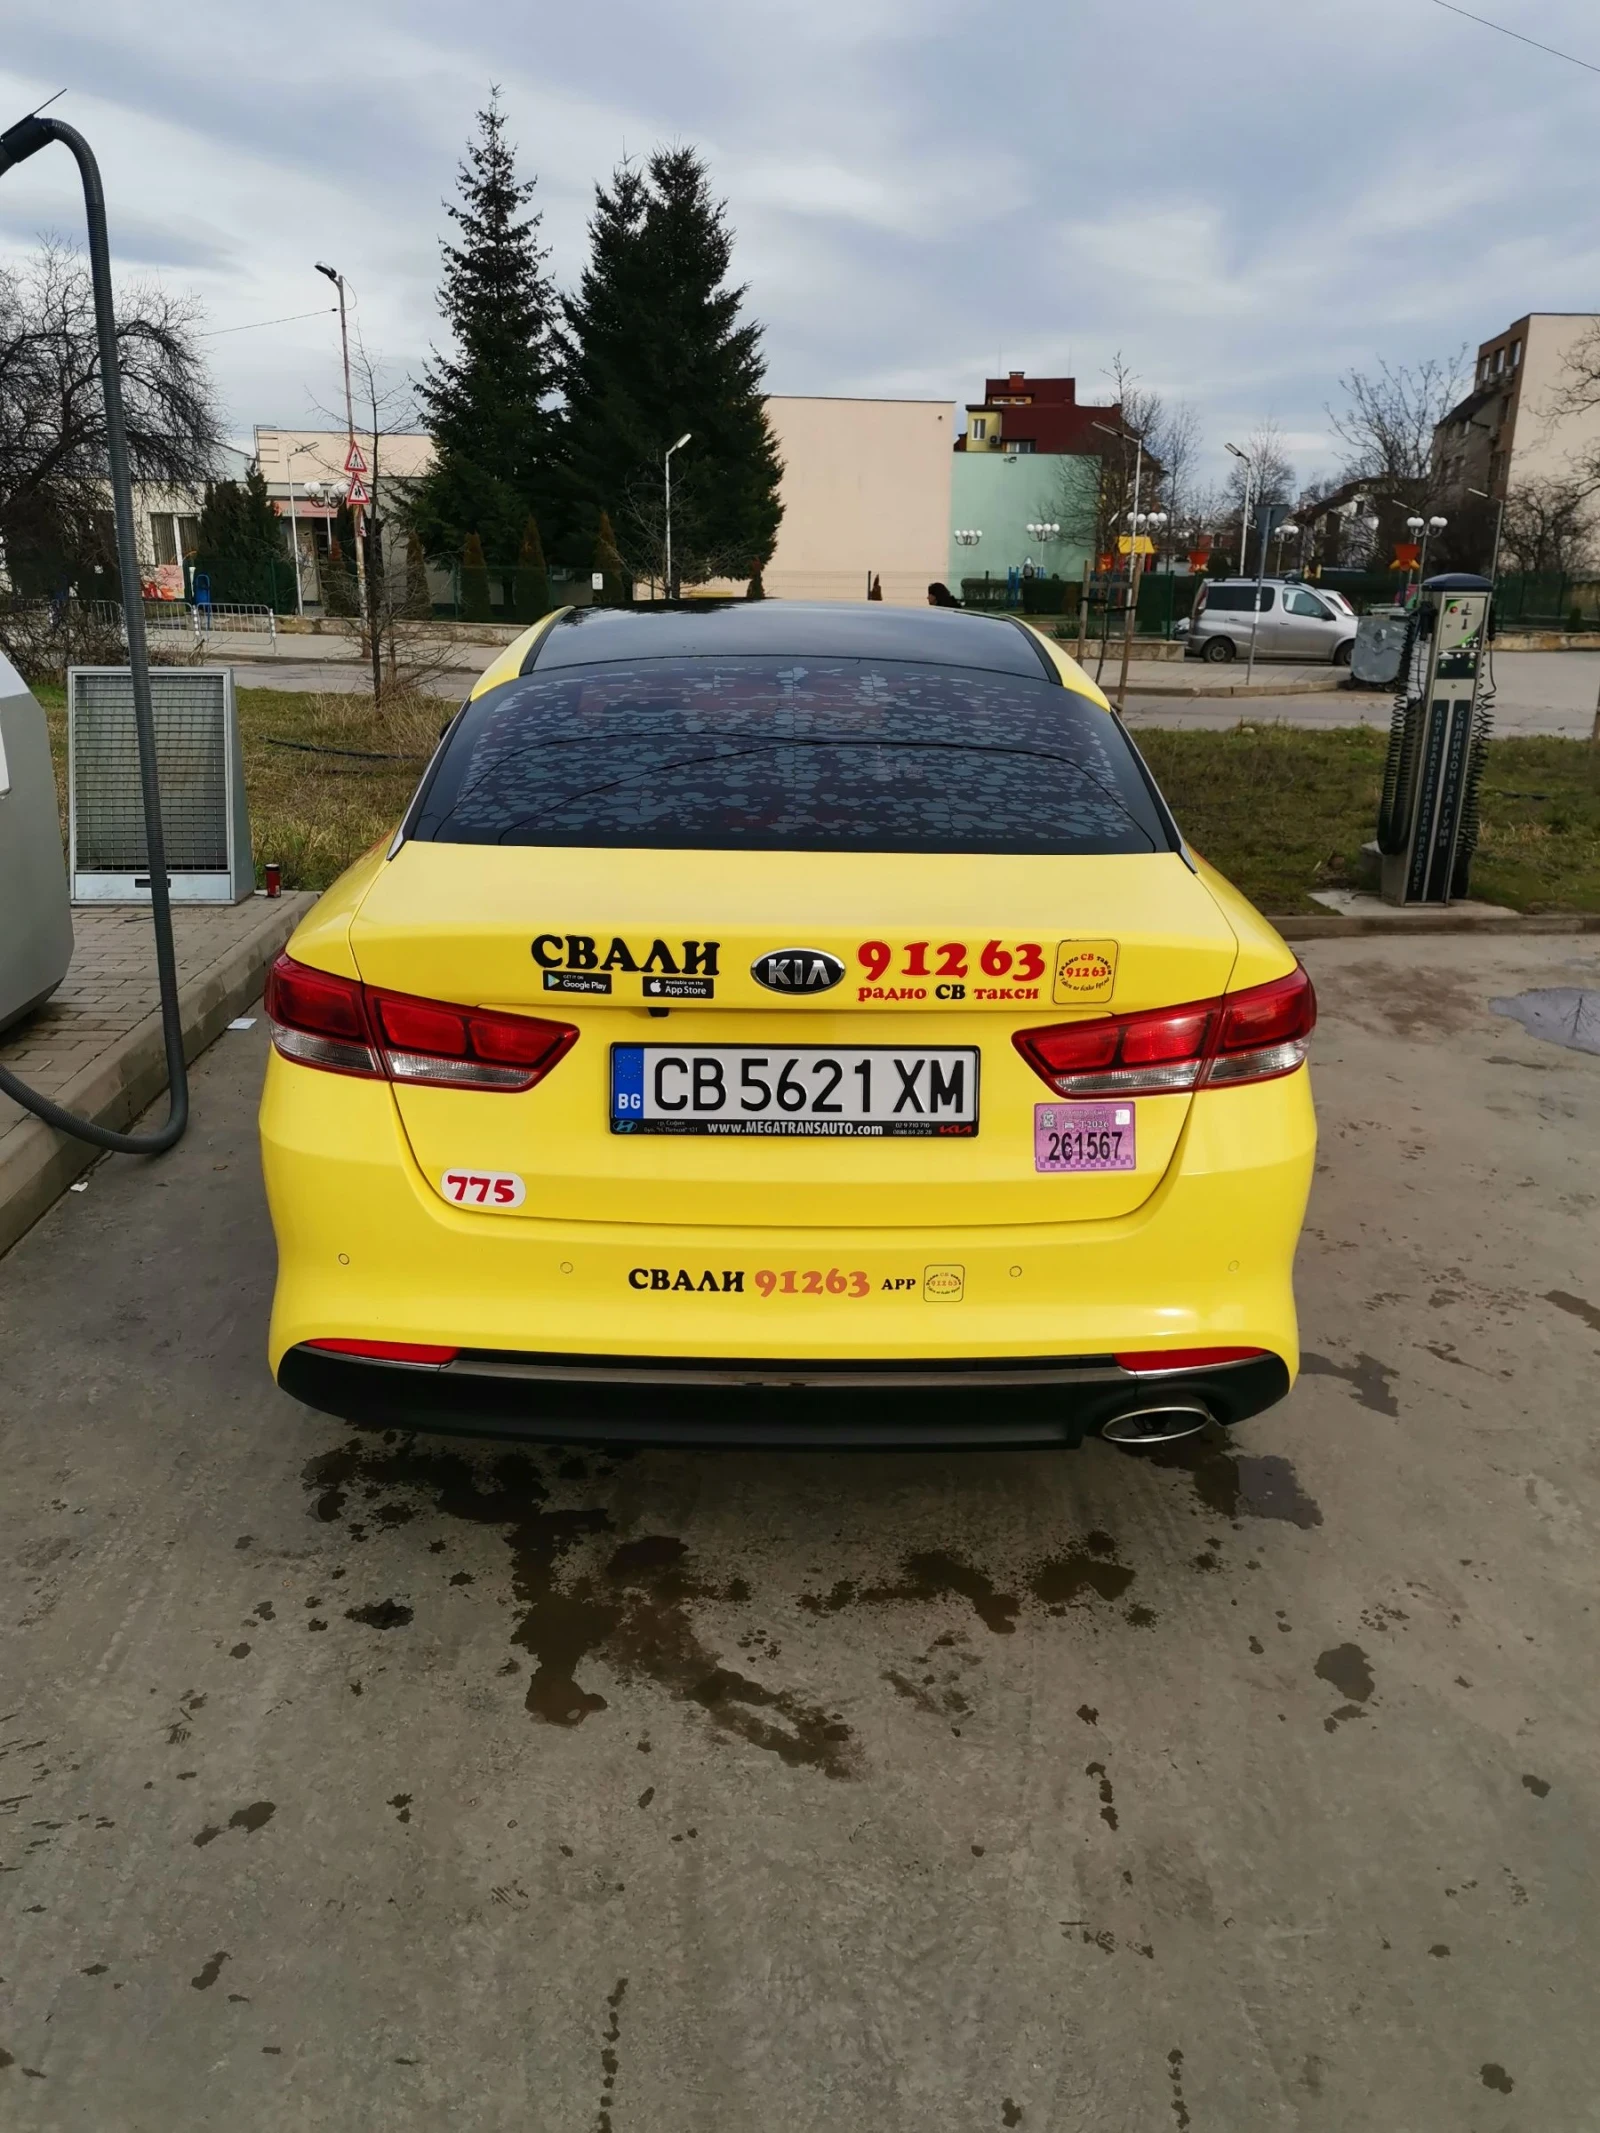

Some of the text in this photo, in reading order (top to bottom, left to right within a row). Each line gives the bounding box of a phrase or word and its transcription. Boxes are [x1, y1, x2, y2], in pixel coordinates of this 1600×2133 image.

[1449, 710, 1464, 780] СИЛИКОН
[531, 934, 720, 976] СВАЛИ
[858, 939, 1046, 982] 91263
[768, 958, 832, 985] KIA
[1066, 966, 1107, 978] 91263
[563, 980, 607, 991] Google Play
[665, 985, 707, 995] App Store
[857, 984, 1039, 1002] радио СВ такси
[618, 1093, 641, 1110] BG
[707, 1121, 883, 1136] www.MEGATRANSAUTO.com
[1048, 1131, 1123, 1160] 261567
[447, 1175, 515, 1203] 775
[628, 1268, 745, 1292] СВАЛИ
[754, 1268, 871, 1298] 91263
